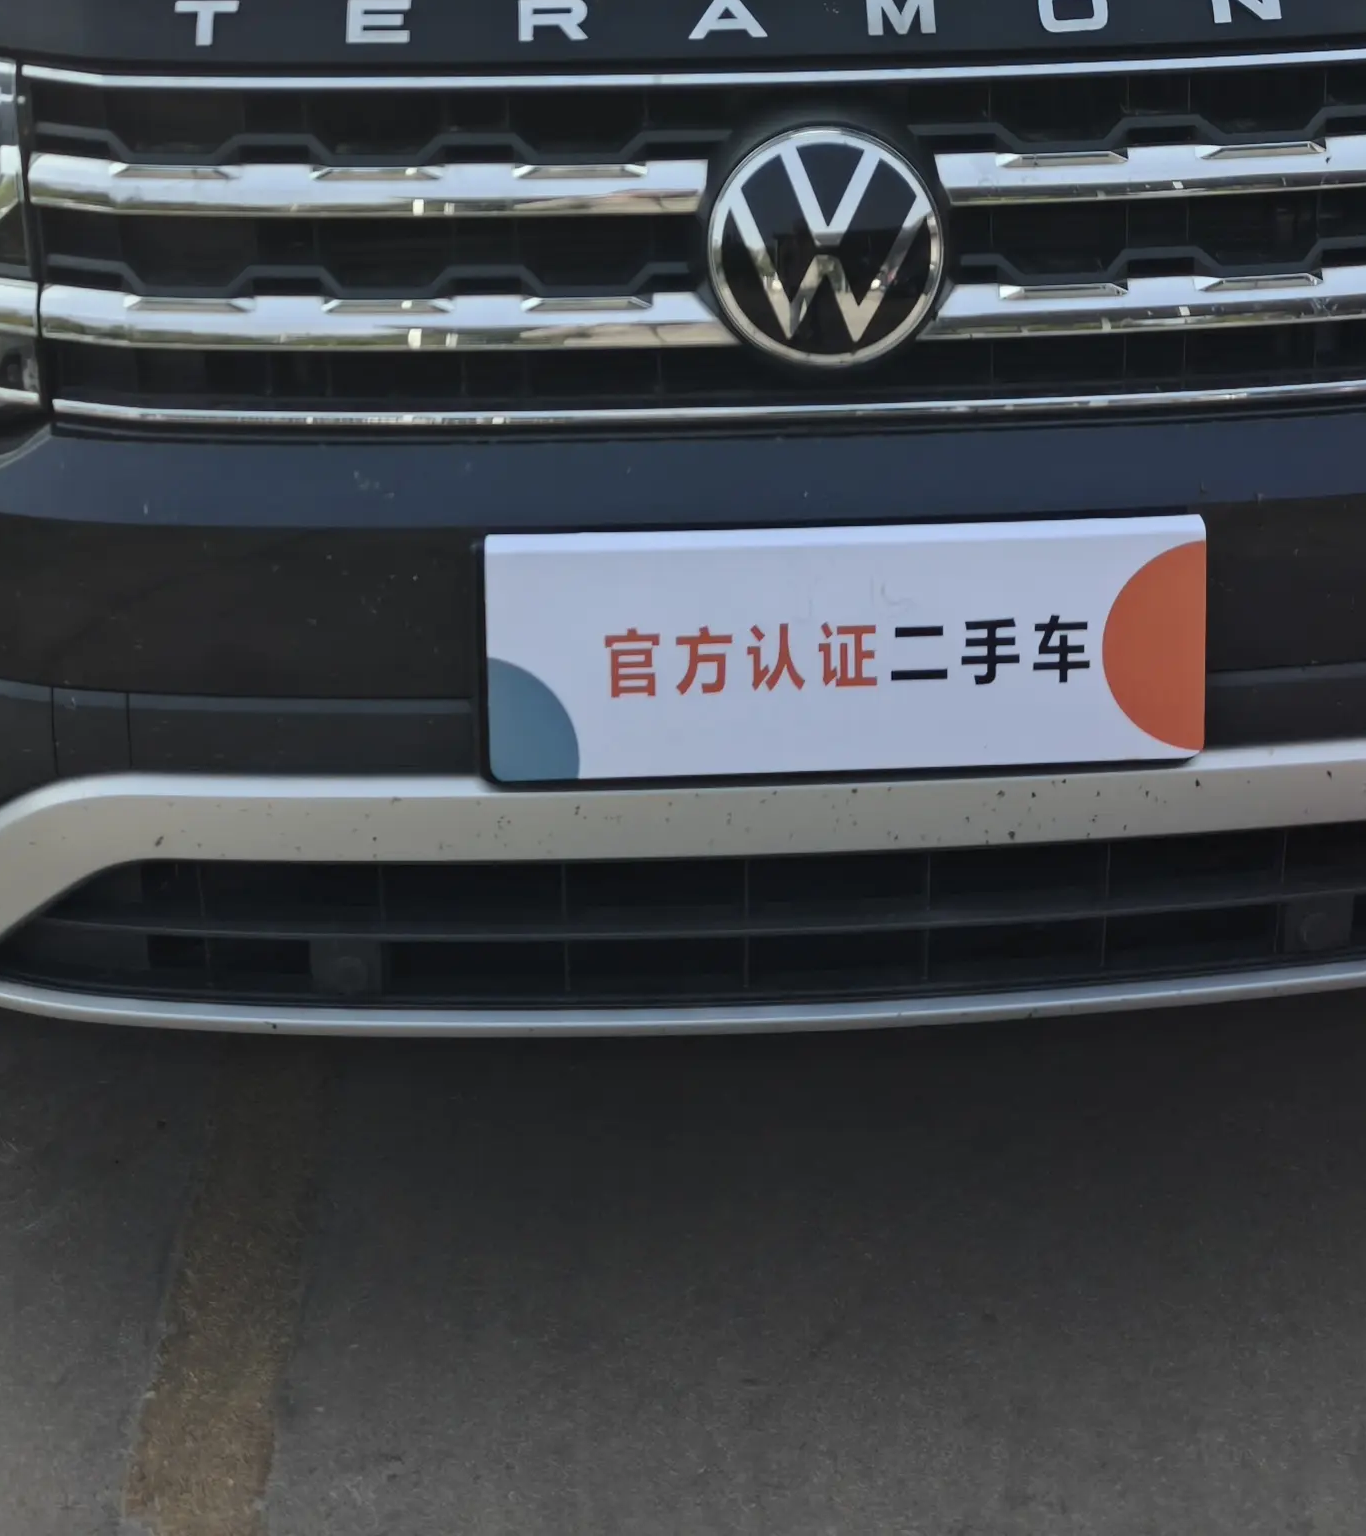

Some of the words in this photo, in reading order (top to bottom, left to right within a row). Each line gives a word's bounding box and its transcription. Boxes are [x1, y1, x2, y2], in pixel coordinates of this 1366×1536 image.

[604, 614, 1093, 699] 官方认证二手车
